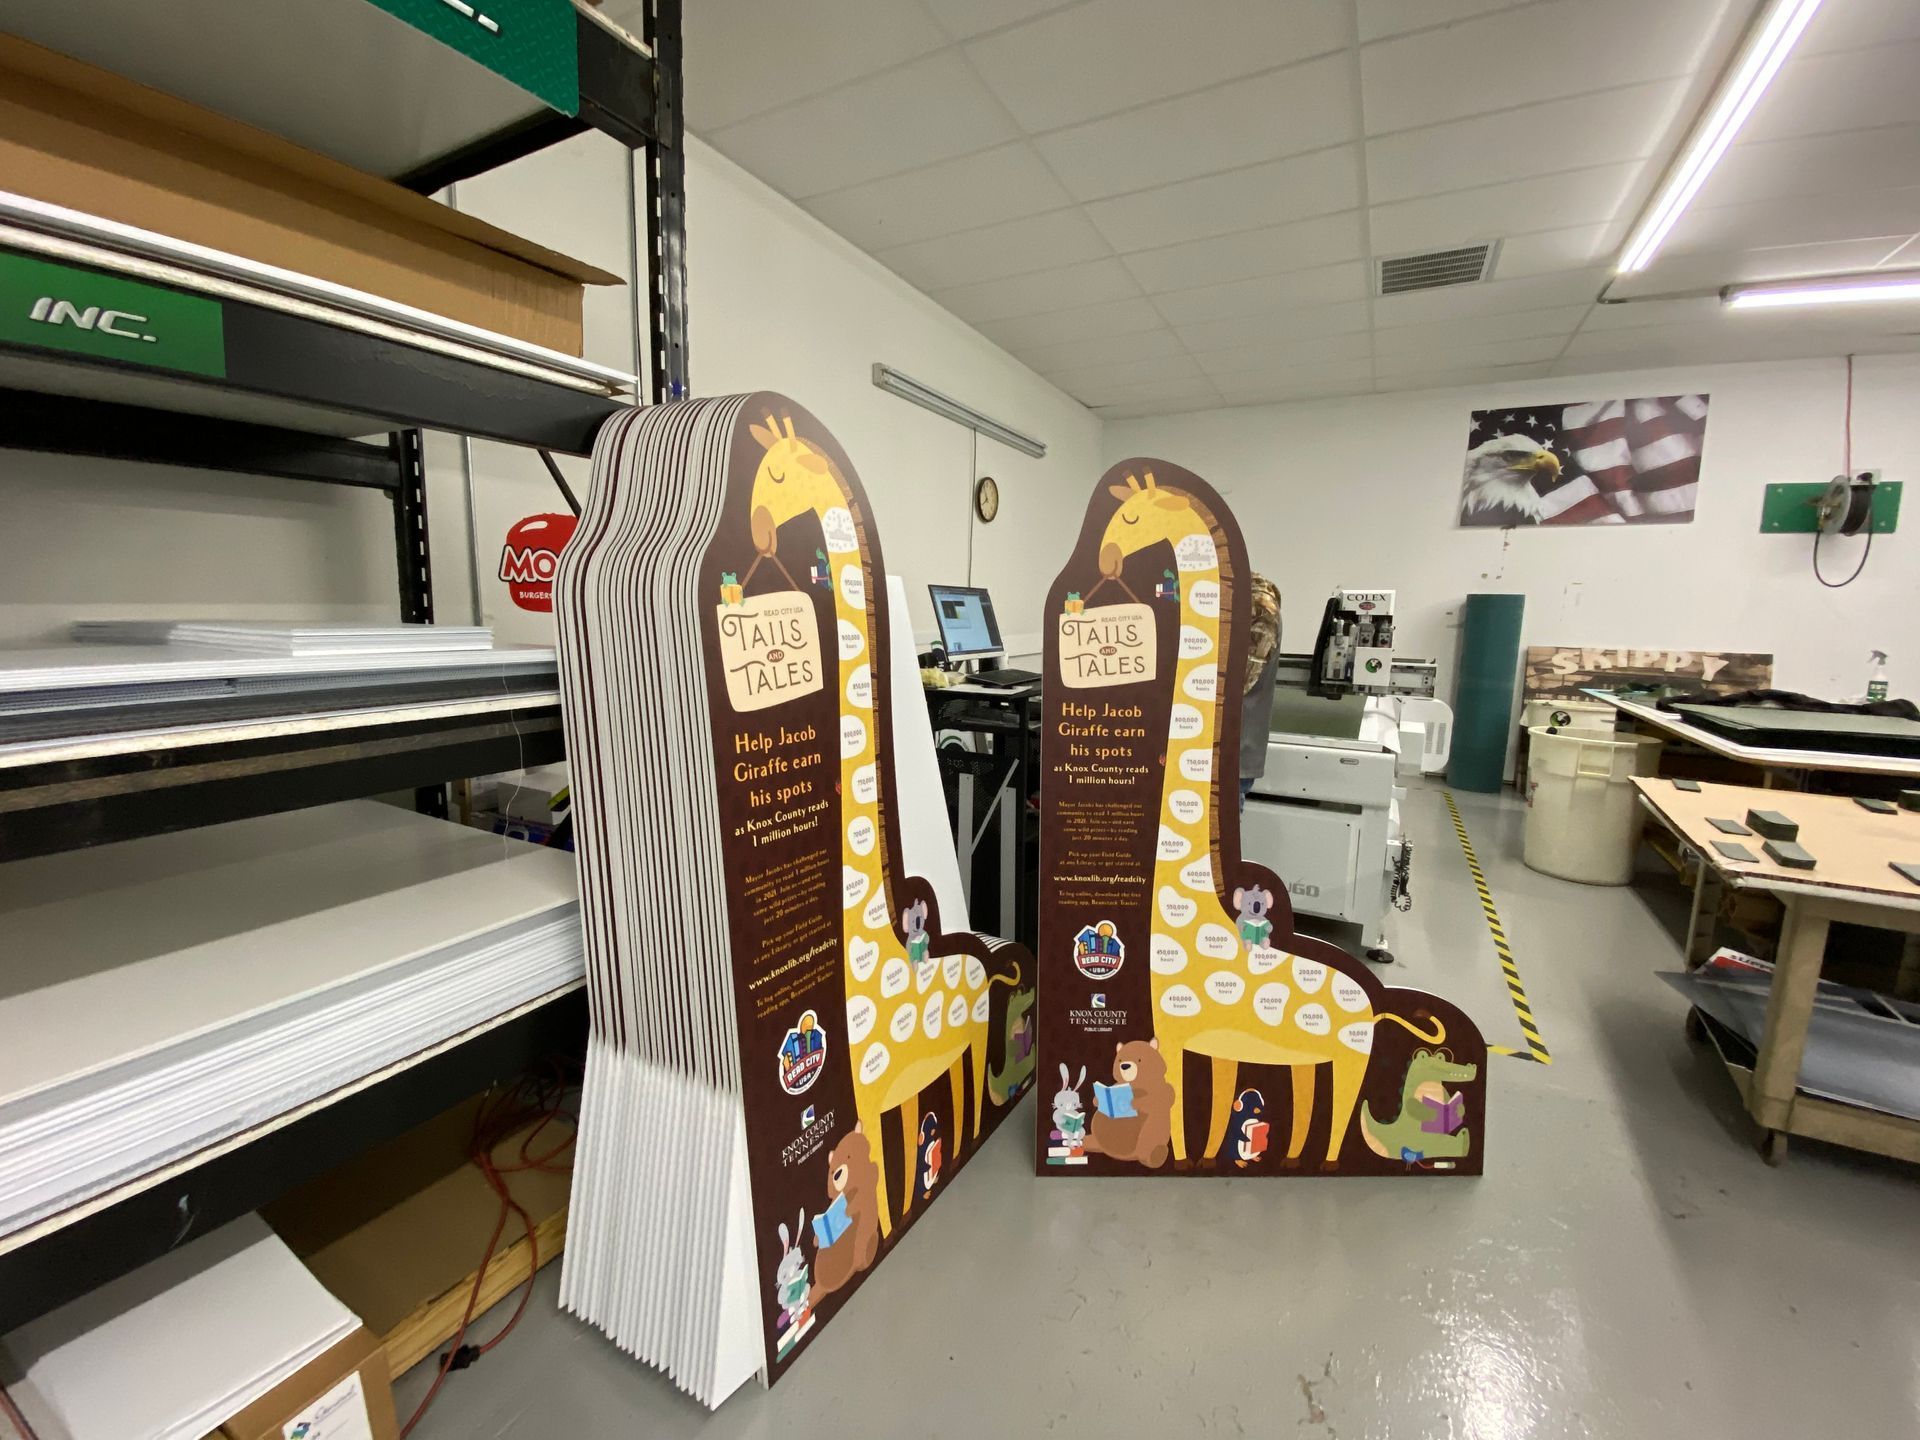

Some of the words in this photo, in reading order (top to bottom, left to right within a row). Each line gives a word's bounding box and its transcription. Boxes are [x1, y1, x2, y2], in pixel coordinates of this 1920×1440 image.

[29, 297, 157, 342] INC.
[722, 612, 808, 650] TAILS
[1062, 620, 1144, 648] TAILS
[768, 652, 783, 661] AND
[1064, 654, 1146, 678] TALES
[1551, 649, 1730, 682] SKIPPY
[730, 660, 812, 696] TALES
[1062, 702, 1096, 720] Help
[1102, 703, 1142, 717] Jacob
[735, 732, 772, 754] Help
[778, 724, 816, 746] Jacob
[1058, 722, 1109, 736] Giraffe
[1114, 728, 1145, 736] earn
[1070, 744, 1090, 756] his
[1095, 746, 1132, 760] spots
[734, 757, 788, 782] Giraffe
[793, 753, 821, 768] earn
[1065, 763, 1088, 772] Knox
[1092, 764, 1123, 775] County
[1108, 776, 1135, 784] hours!
[750, 790, 772, 808] his
[777, 781, 812, 804] spots
[734, 825, 745, 836] as
[747, 819, 772, 832] Knox
[775, 808, 806, 823] County
[808, 800, 829, 812] reads
[761, 828, 792, 845] million
[793, 816, 818, 834] hours!
[1054, 874, 1146, 884] www.knoxlib.org/readcity
[749, 938, 838, 990] www.knoxlib.org/readcity
[1082, 956, 1100, 965] READ
[1100, 956, 1117, 965] CITY
[786, 1062, 804, 1084] READ
[806, 1054, 820, 1068] CITY
[782, 1137, 804, 1159] KNOX
[804, 1110, 834, 1140] COUNTY
[782, 1120, 835, 1168] TENNESSEE
